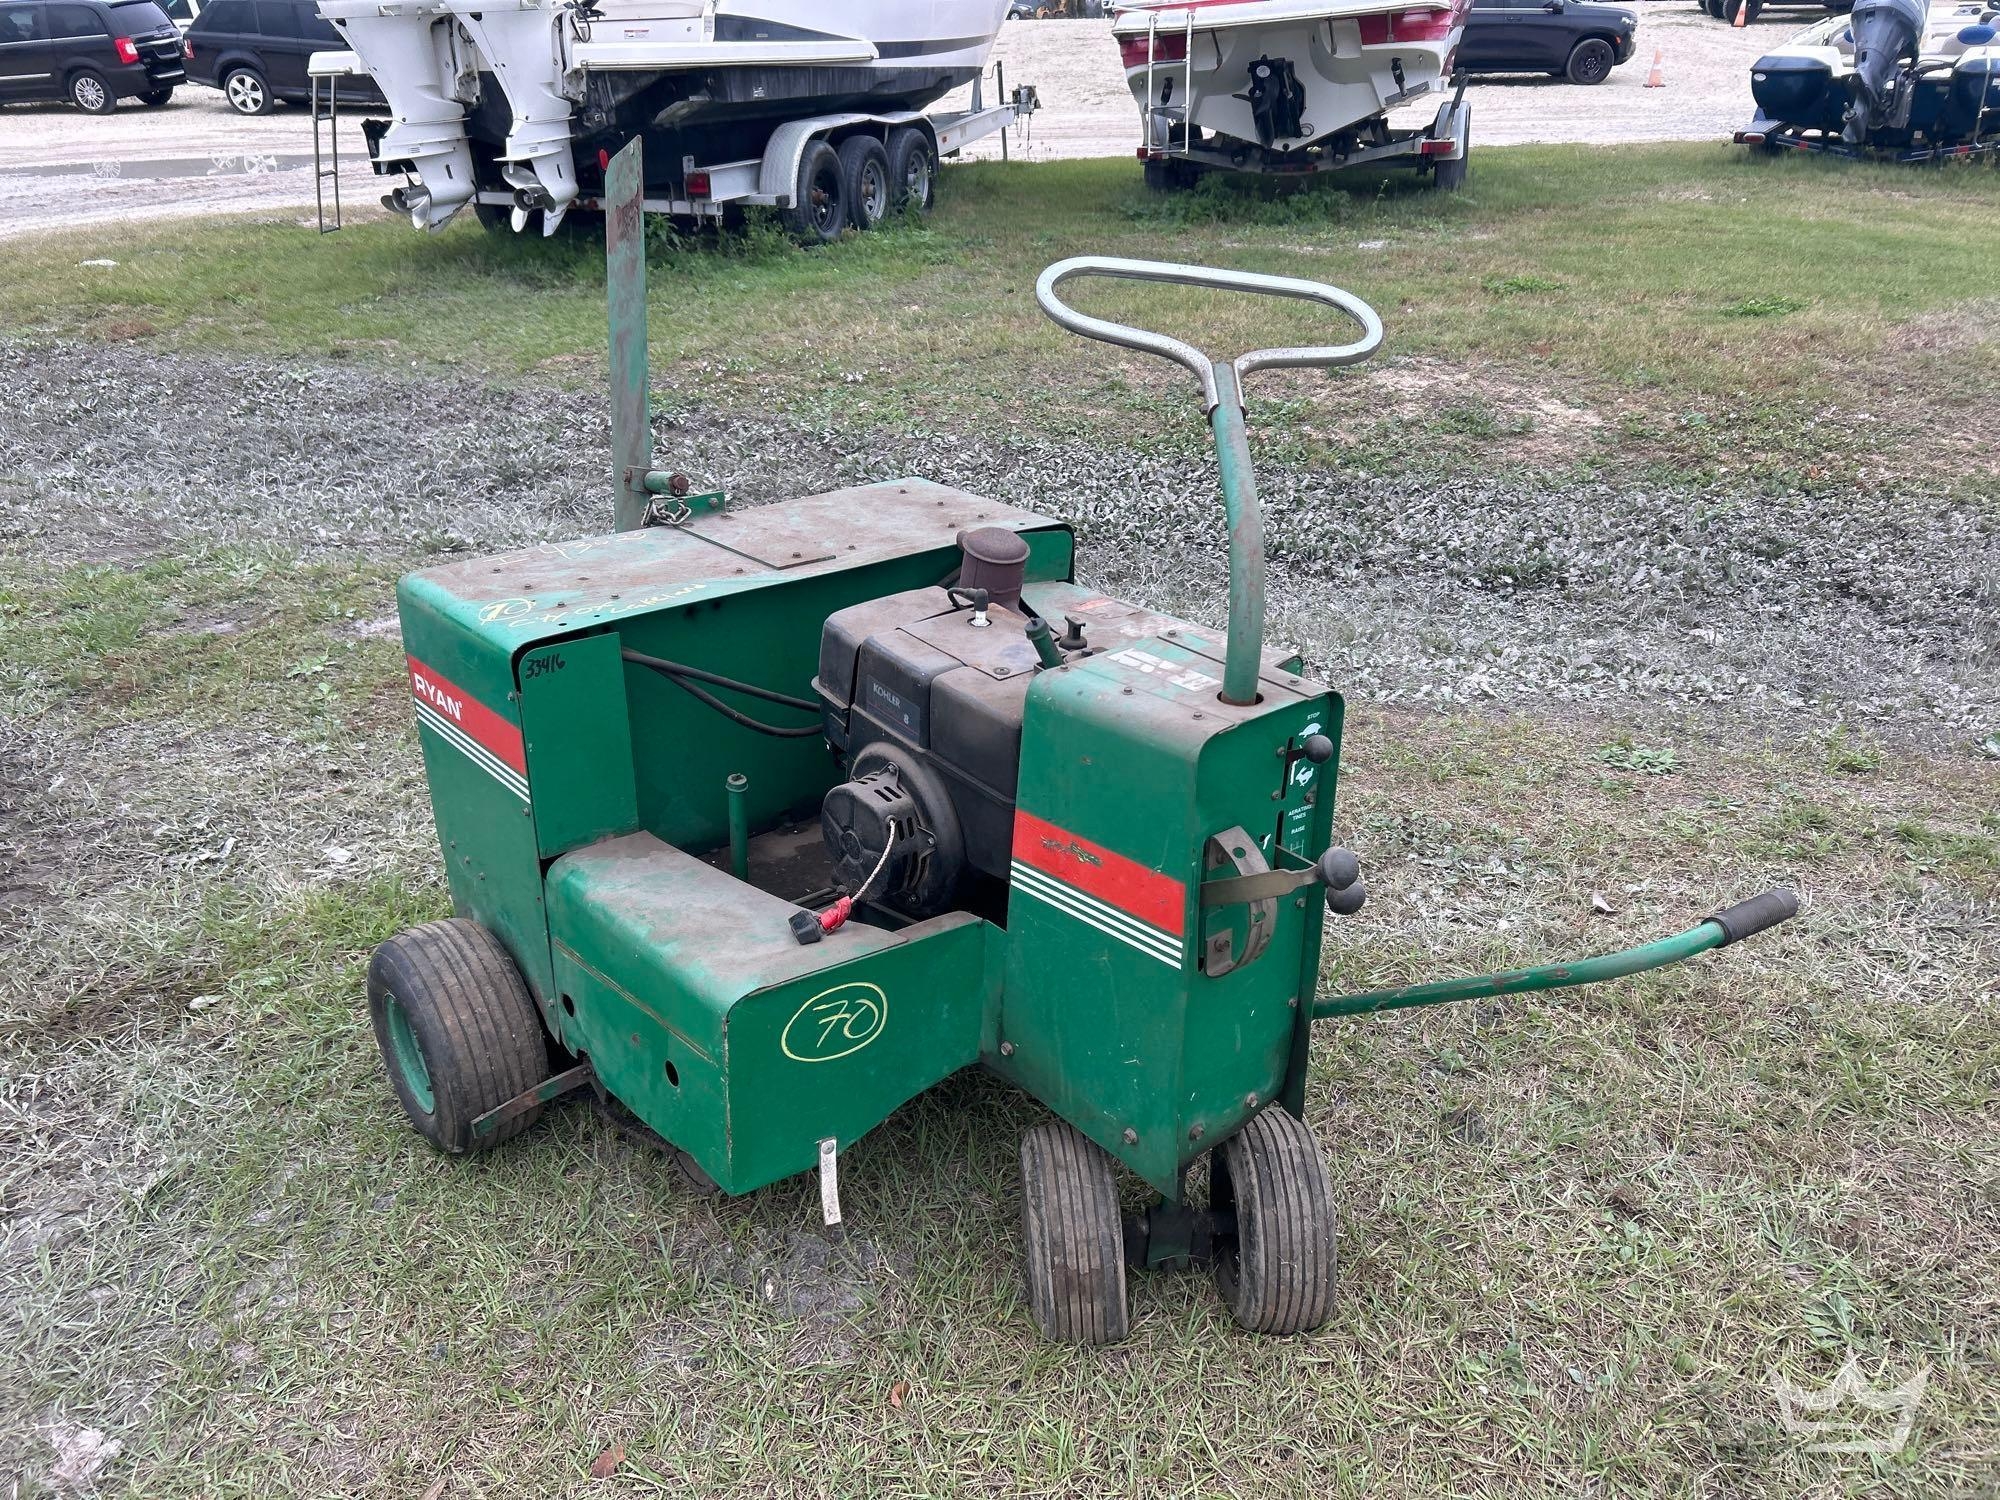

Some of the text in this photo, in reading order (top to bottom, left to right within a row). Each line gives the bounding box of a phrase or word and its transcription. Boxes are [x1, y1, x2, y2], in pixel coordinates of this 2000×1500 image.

[525, 653, 566, 680] 33416
[413, 672, 461, 721] RYAN
[873, 683, 901, 709] KOHLER
[1306, 711, 1321, 721] STOP
[1290, 825, 1305, 835] RAISE
[812, 998, 879, 1049] 70
